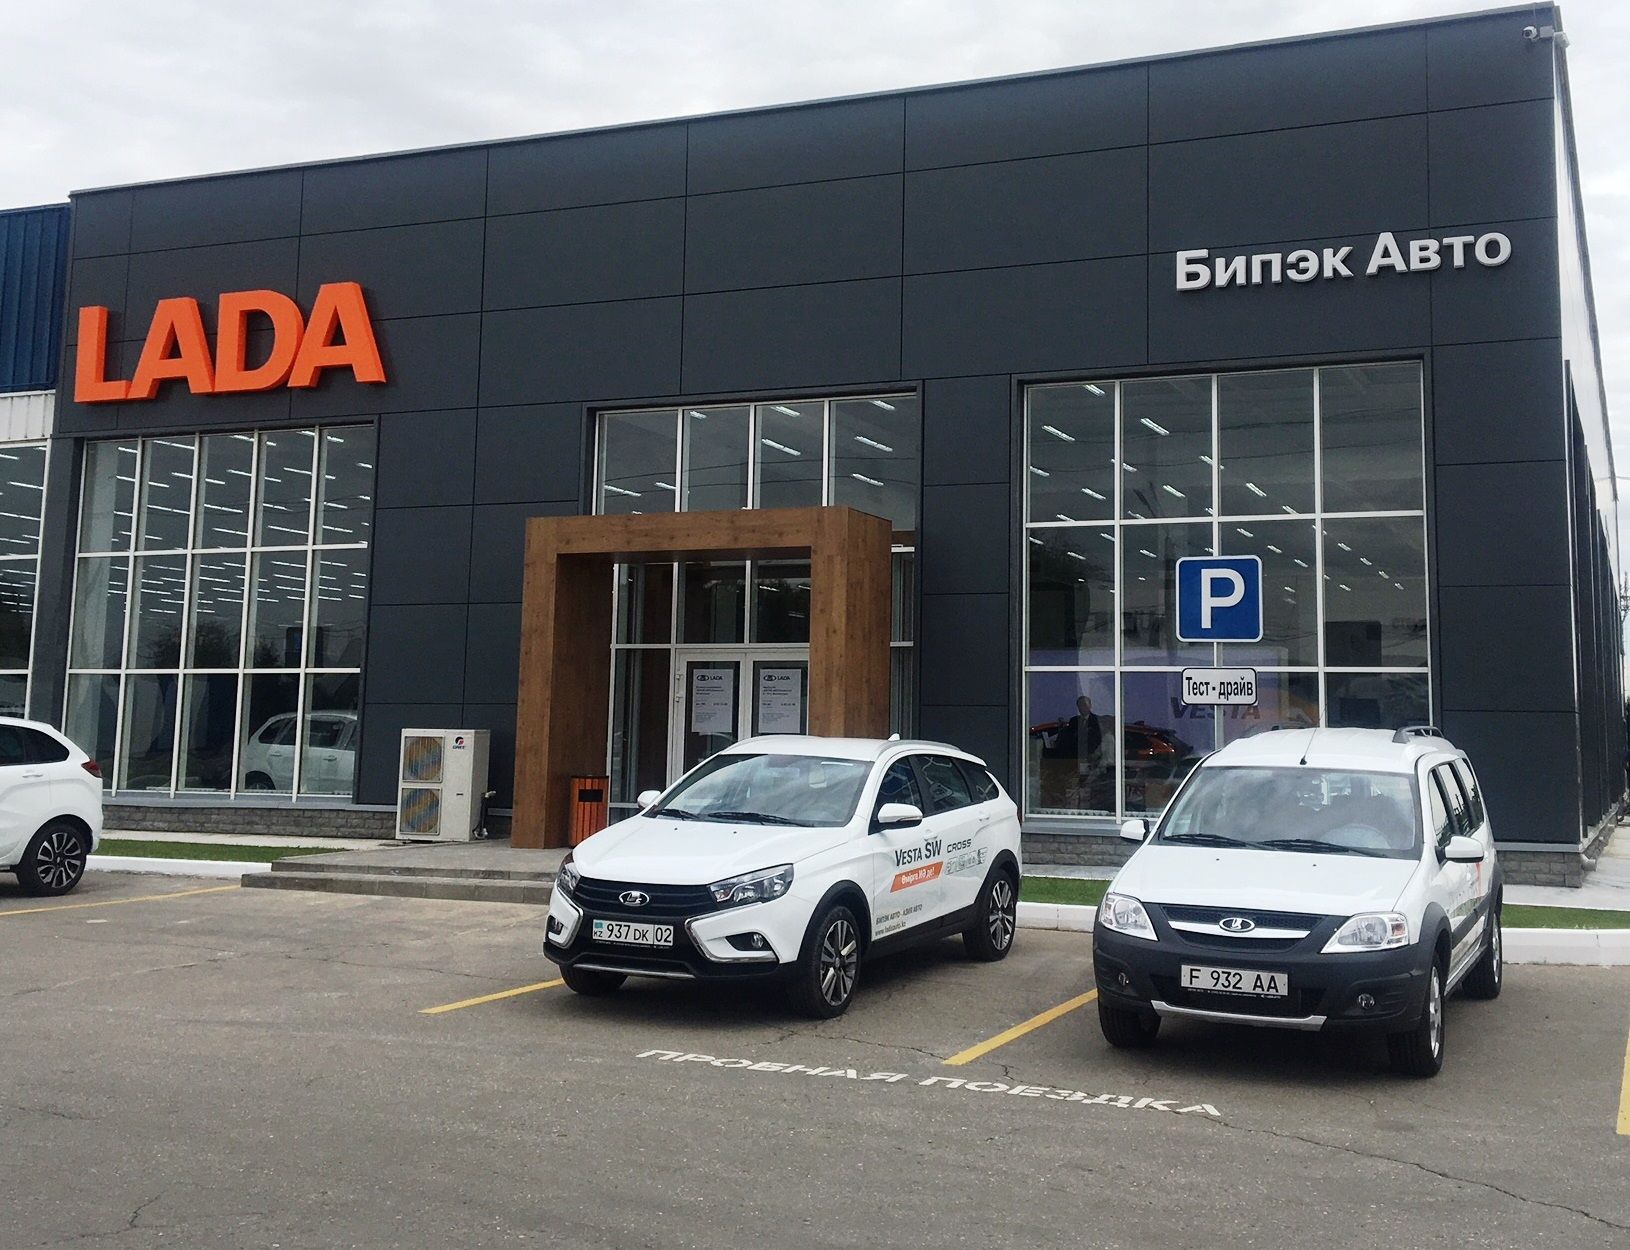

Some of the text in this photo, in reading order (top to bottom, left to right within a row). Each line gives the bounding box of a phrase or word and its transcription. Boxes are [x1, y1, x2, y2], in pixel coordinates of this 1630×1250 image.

[1176, 231, 1512, 291] Бипэк Авто
[74, 281, 386, 403] LADA
[1201, 568, 1245, 628] P
[1171, 696, 1261, 719] VEA
[925, 839, 942, 859] SW
[947, 839, 972, 854] CROSS
[593, 923, 672, 943] KZ 937 DK 02
[1189, 968, 1279, 993] F 932 AA
[635, 1050, 1221, 1116] ПРОБНАЯ ПОЕЗДКА
